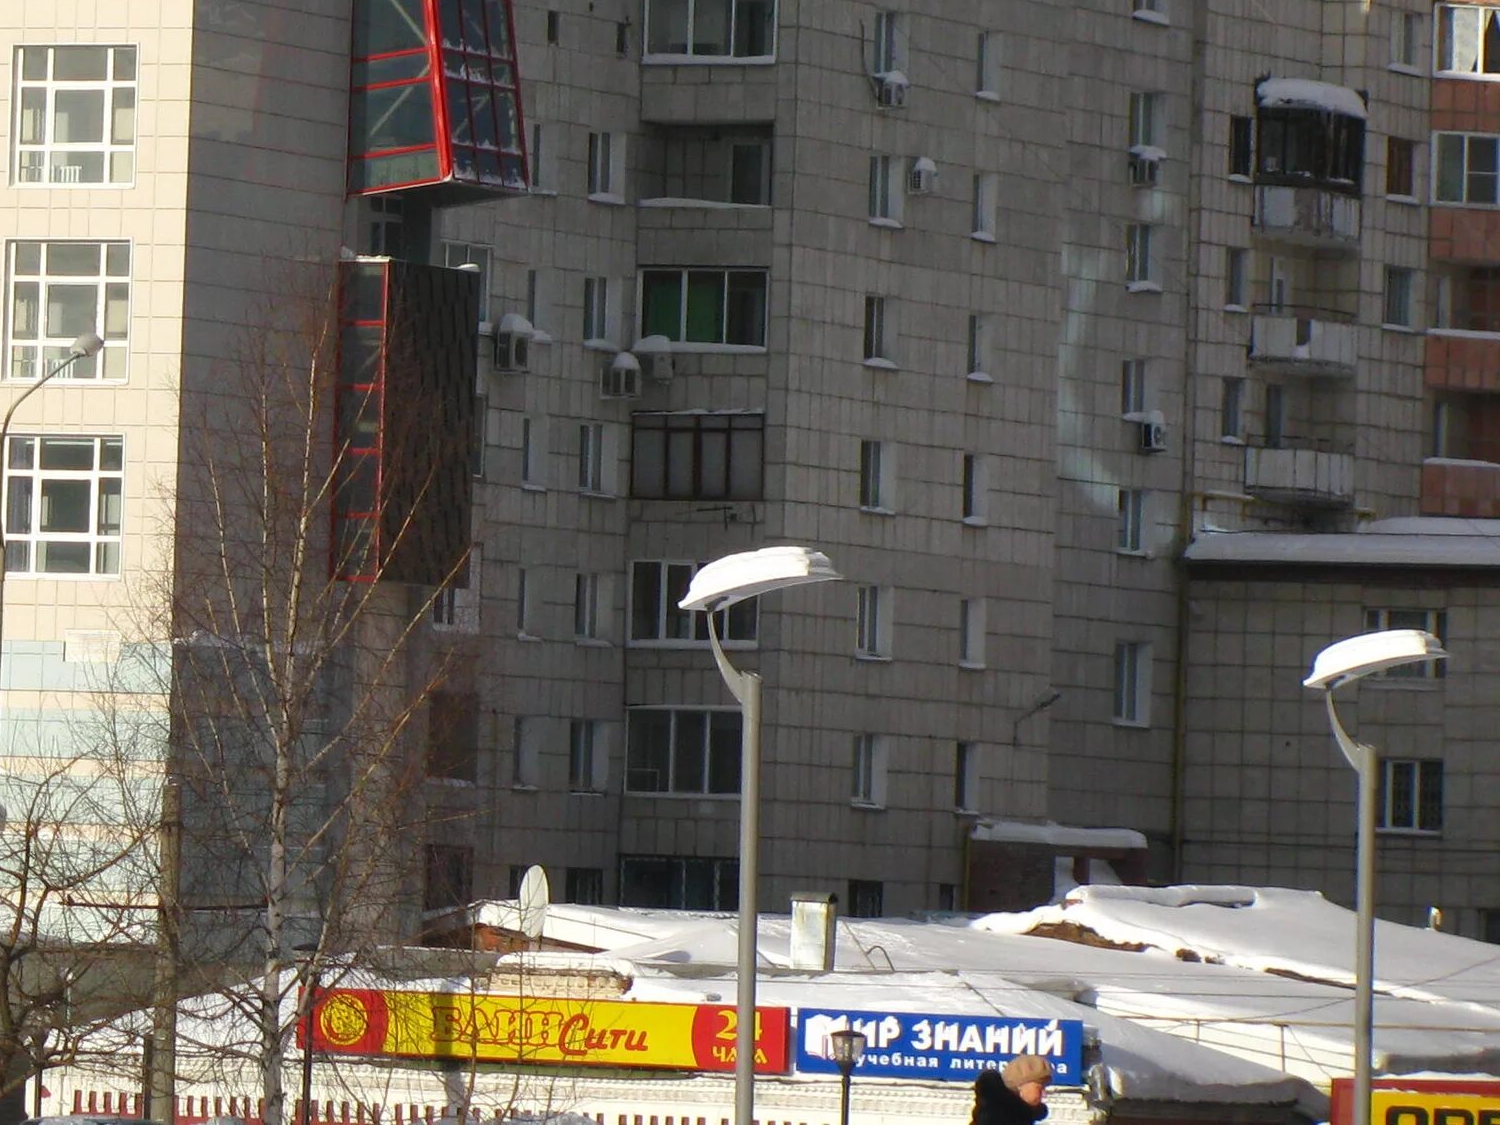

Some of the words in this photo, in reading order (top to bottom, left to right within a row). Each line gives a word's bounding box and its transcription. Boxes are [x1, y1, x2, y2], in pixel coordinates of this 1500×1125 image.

[911, 1018, 1064, 1056] ЗНАНИЙ
[712, 1045, 768, 1064] ЧАА
[855, 1052, 939, 1068] учебная
